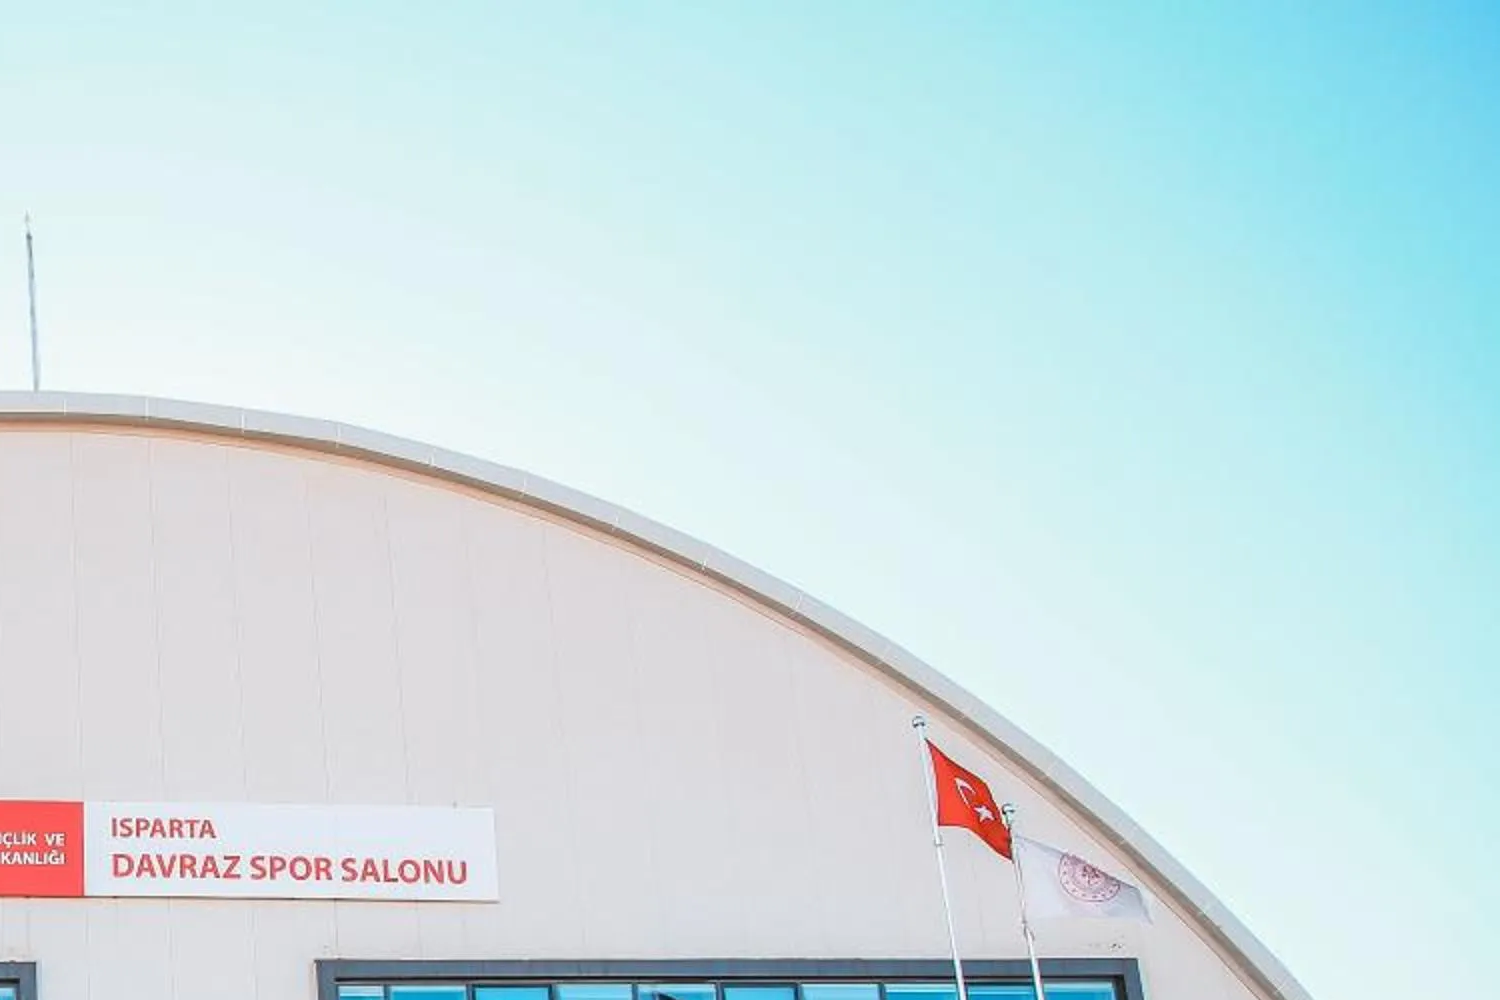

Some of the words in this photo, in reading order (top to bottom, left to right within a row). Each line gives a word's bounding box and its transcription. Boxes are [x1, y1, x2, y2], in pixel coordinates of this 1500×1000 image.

[111, 818, 217, 839] ISPARTA
[45, 834, 65, 846] VE
[111, 853, 241, 880] DAVRAZ
[250, 856, 333, 881] SPOR
[341, 858, 468, 884] SALONU
